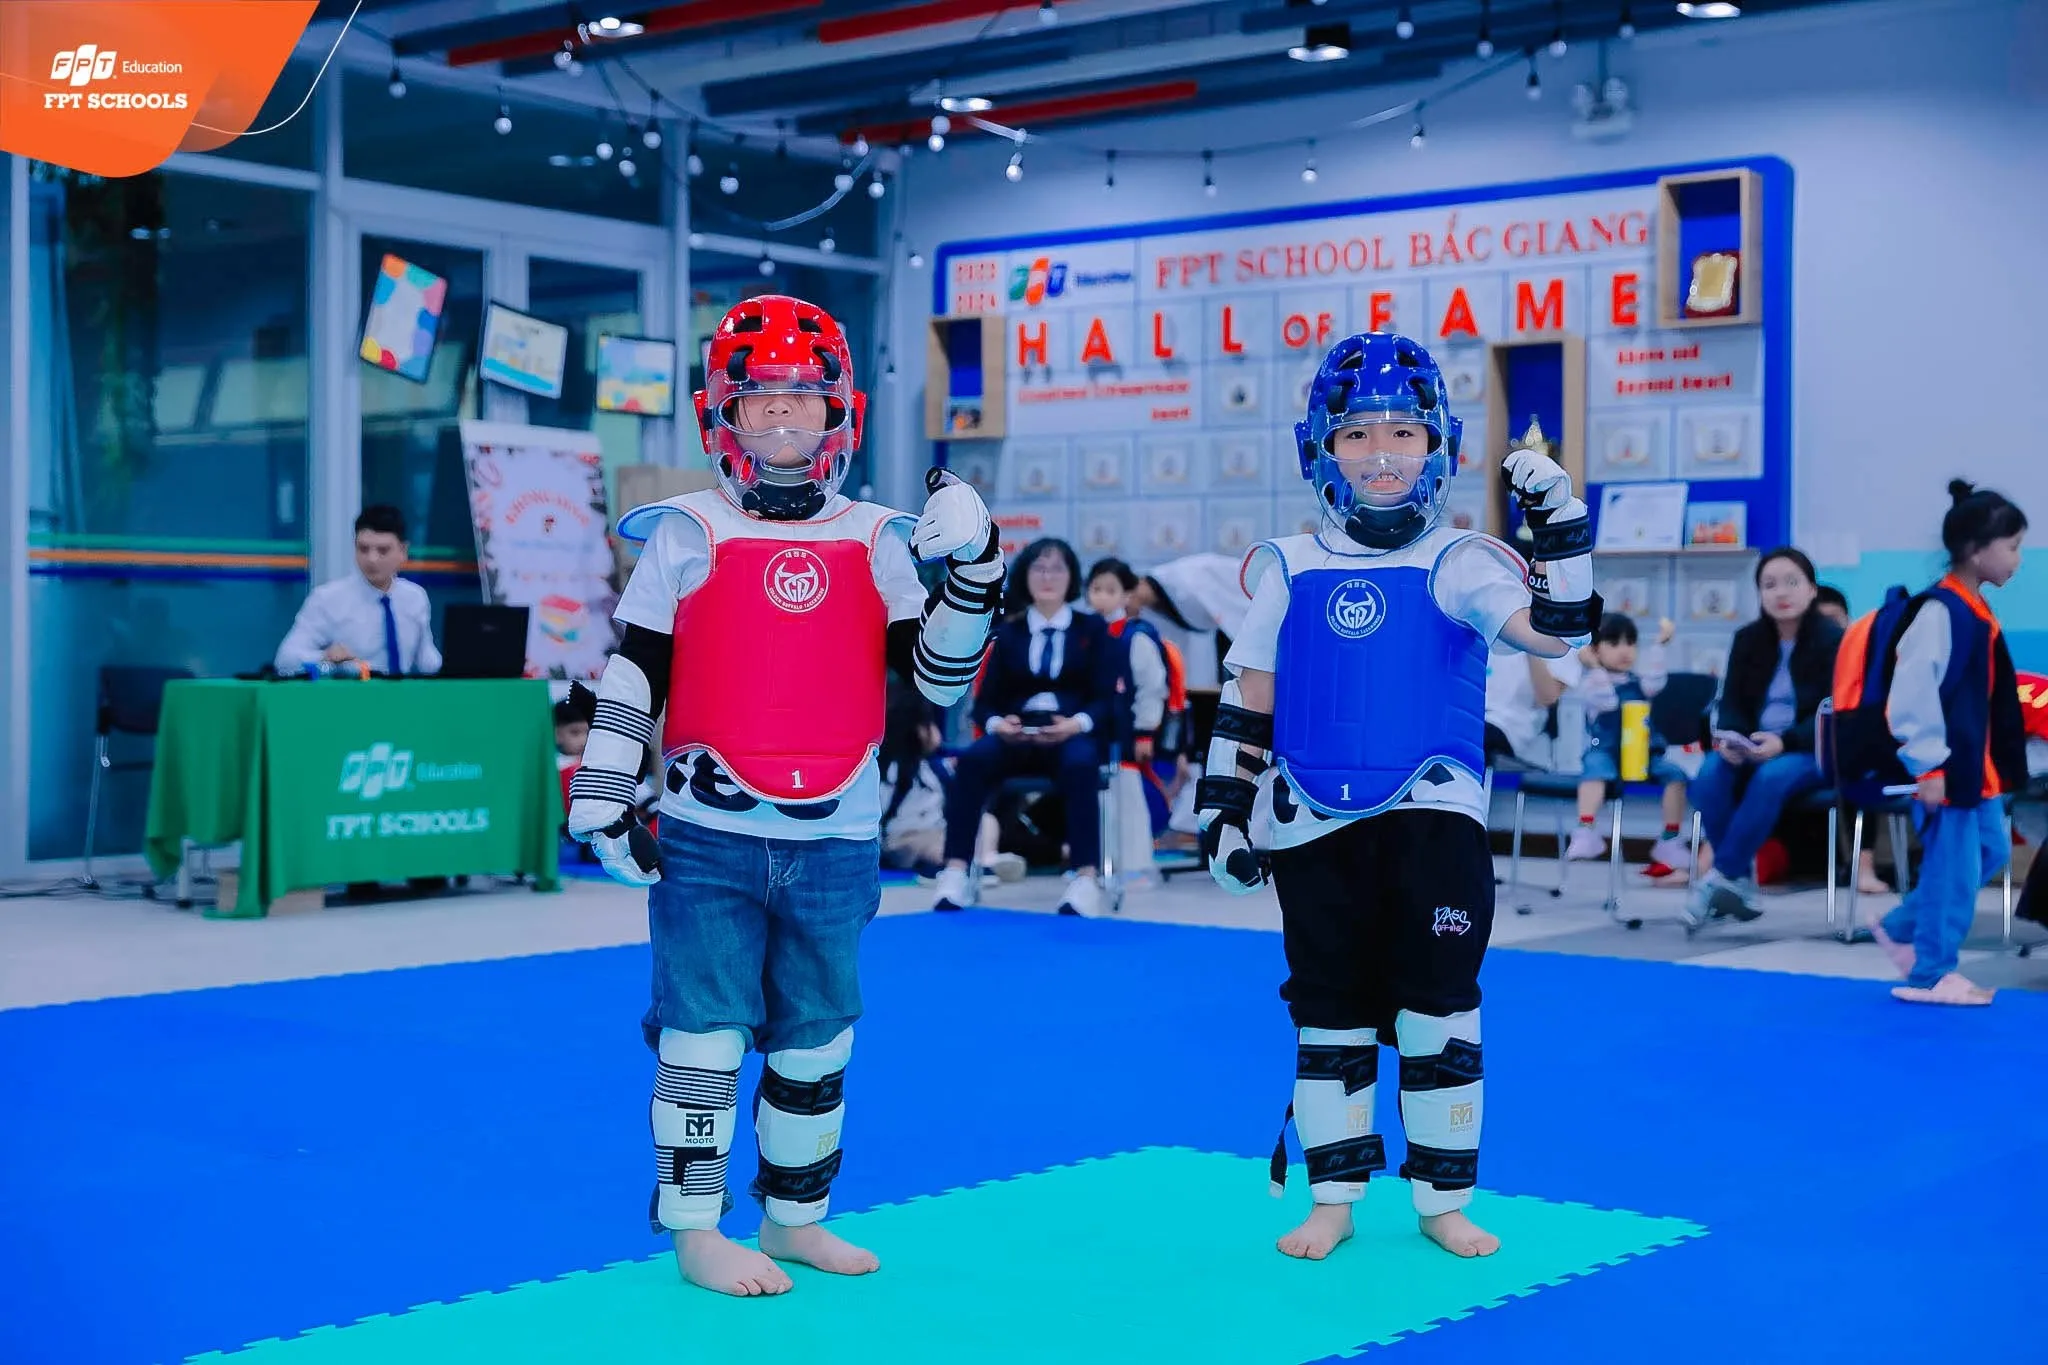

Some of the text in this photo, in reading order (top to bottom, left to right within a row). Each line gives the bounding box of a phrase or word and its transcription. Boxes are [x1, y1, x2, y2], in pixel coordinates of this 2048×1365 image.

[1157, 254, 1222, 288] FPT
[1236, 237, 1393, 282] SCHOOL
[1503, 212, 1646, 256] GIANG
[1018, 272, 1640, 367] HALL OF FAME
[791, 769, 804, 789] 1
[1340, 783, 1351, 801] 1
[684, 1137, 715, 1145] MOOTO
